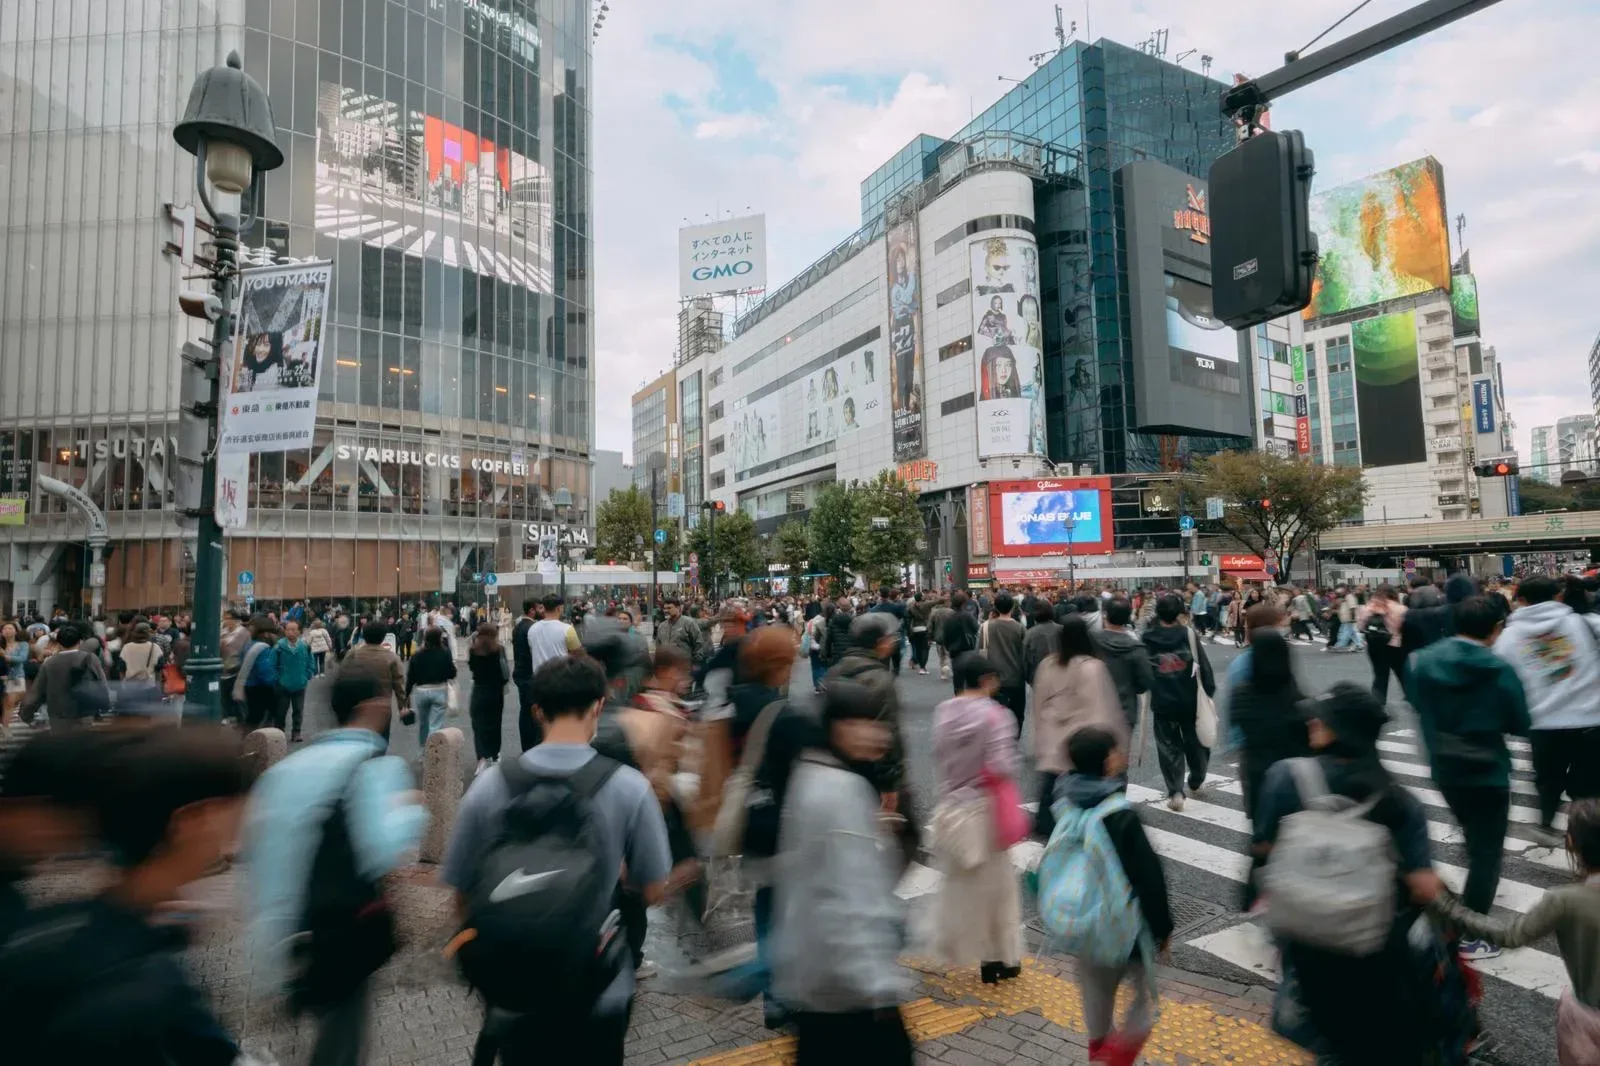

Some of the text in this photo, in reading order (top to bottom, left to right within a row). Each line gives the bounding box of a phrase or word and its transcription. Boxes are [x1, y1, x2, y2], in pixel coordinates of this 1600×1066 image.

[691, 231, 753, 250] すべての人に
[691, 243, 753, 262] インターネット
[284, 271, 327, 288] MAKE
[692, 260, 753, 281] GMO
[337, 444, 529, 477] STARBUCKS COFFEE
[1037, 481, 1062, 491] Glico
[1491, 521, 1510, 531] JR
